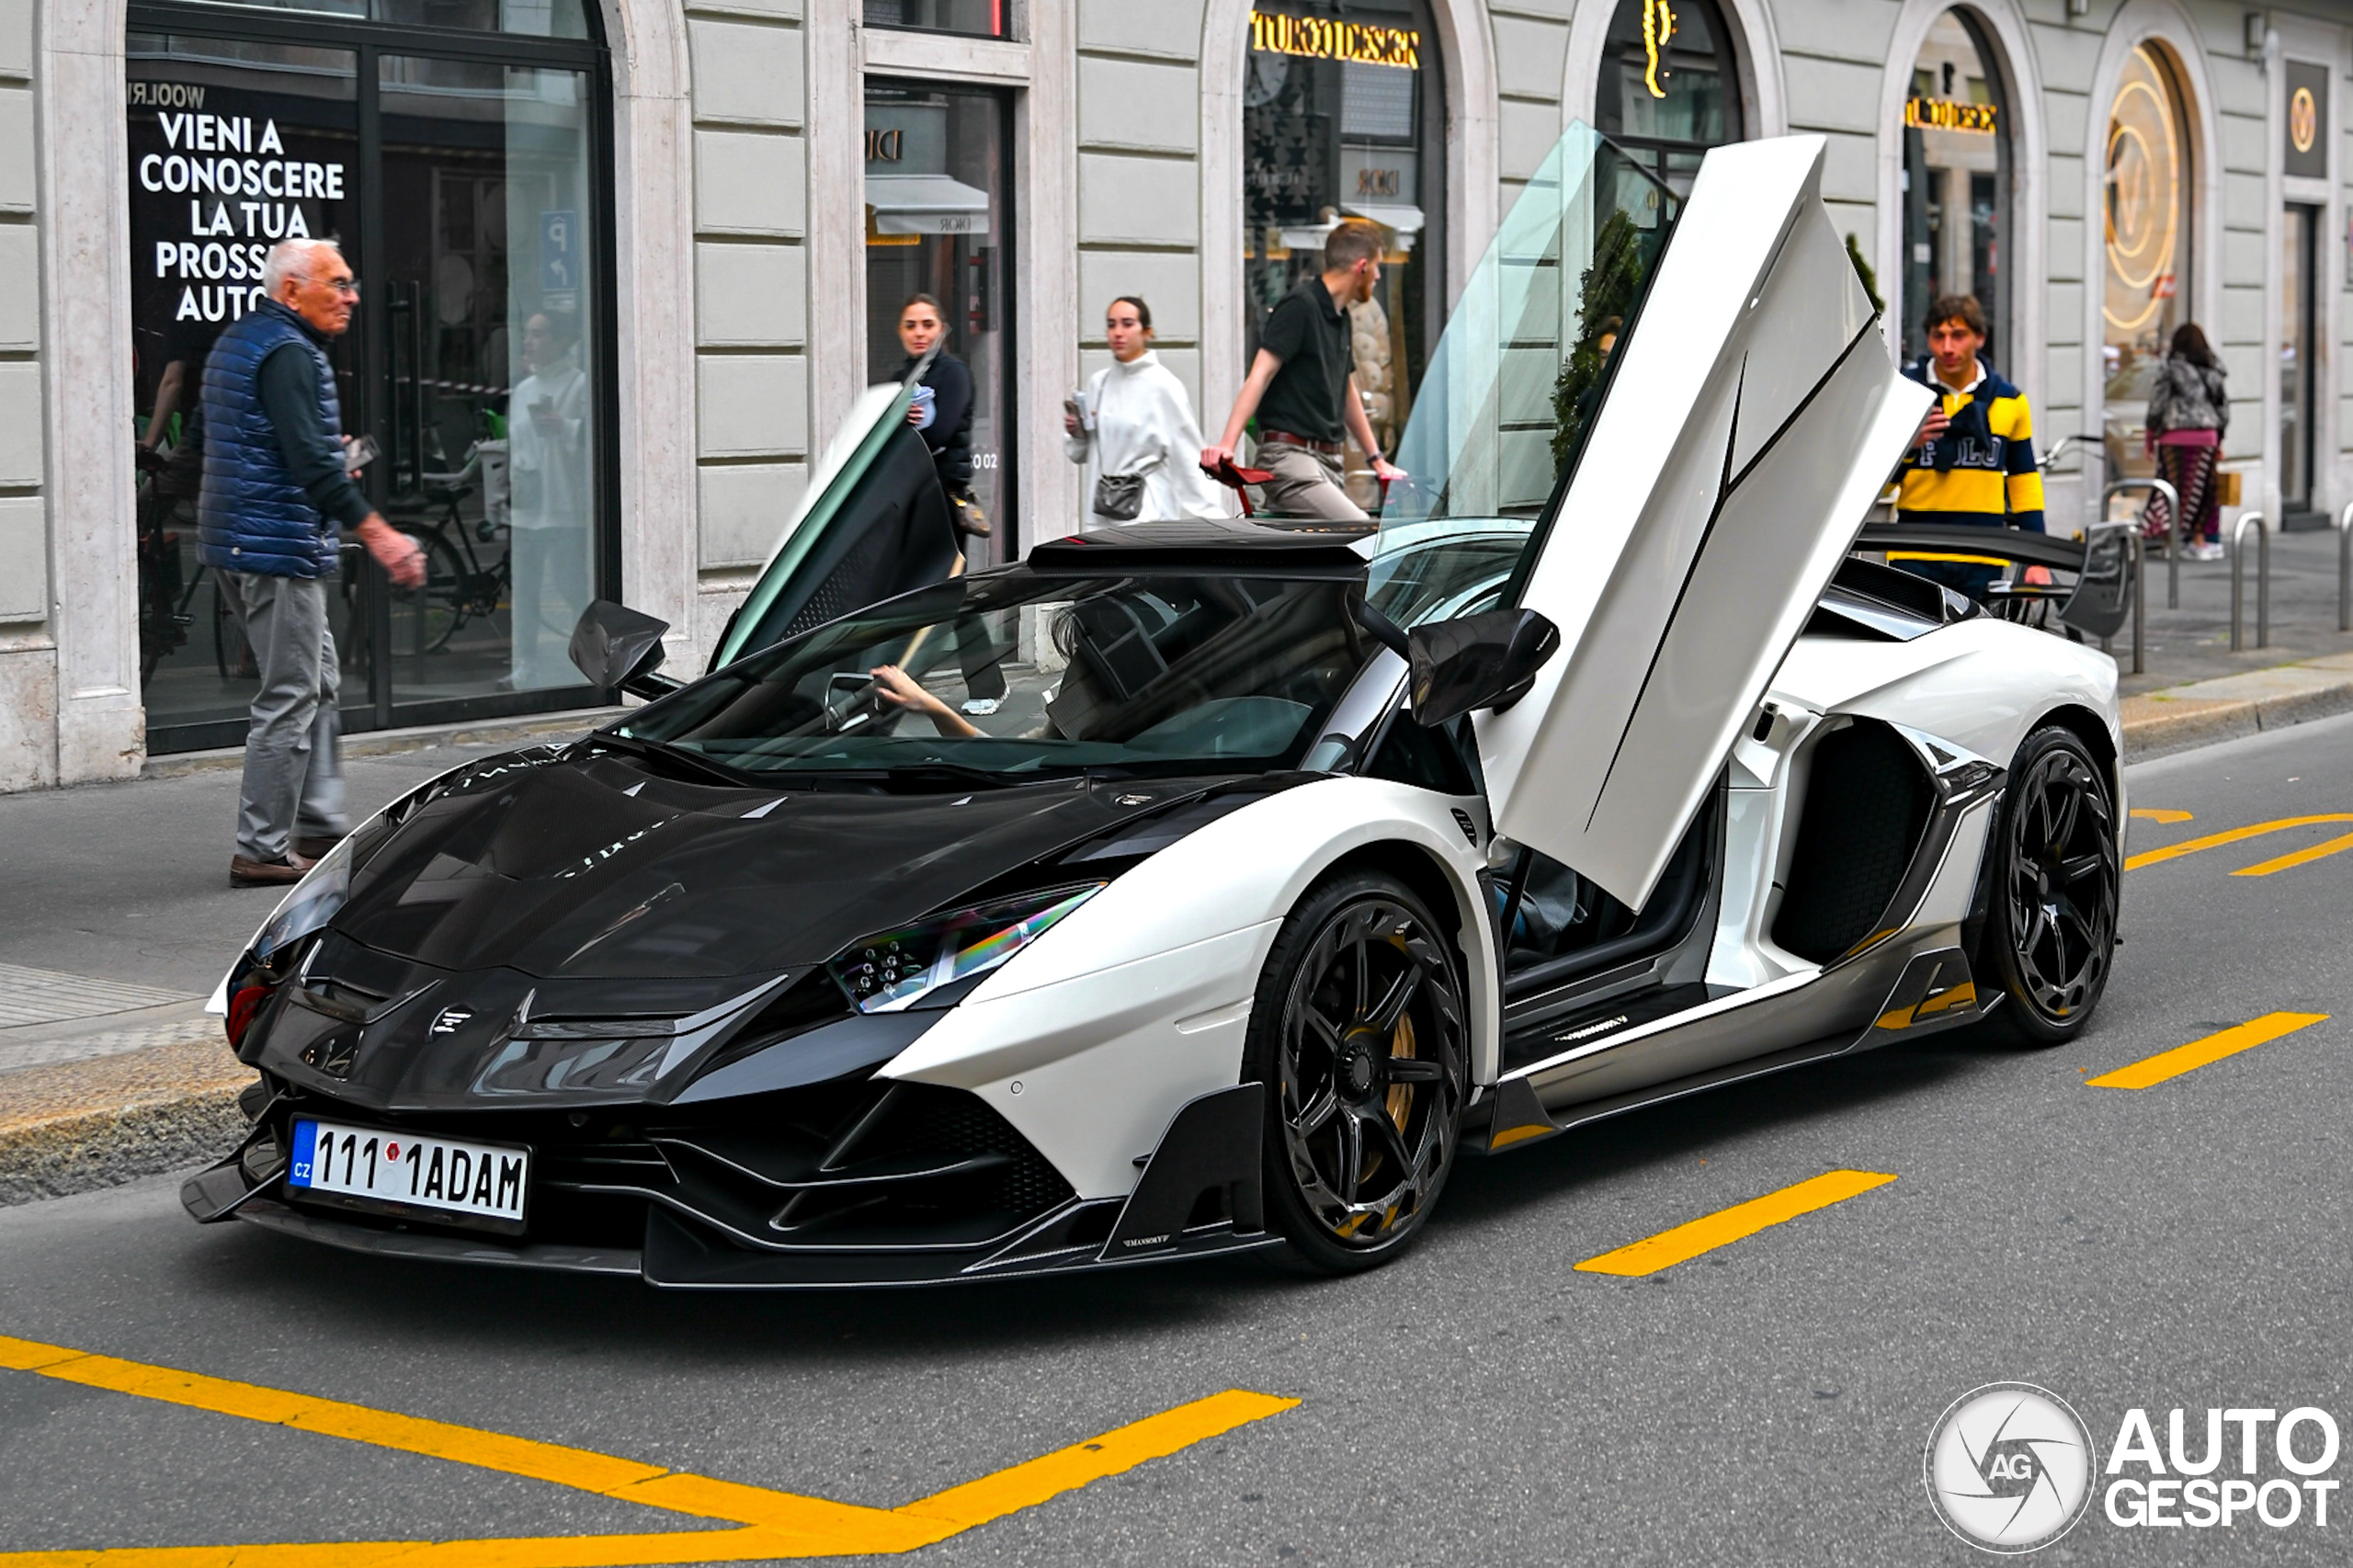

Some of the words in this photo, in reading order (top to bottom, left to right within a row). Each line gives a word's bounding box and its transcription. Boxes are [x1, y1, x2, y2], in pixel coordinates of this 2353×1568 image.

[158, 111, 252, 153] VIENI
[258, 118, 284, 154] A
[140, 153, 345, 199] CONOSCERE
[191, 199, 234, 236] LA
[240, 202, 310, 239] TUA
[156, 241, 276, 280] PROSS
[1919, 436, 2002, 468] PLO
[294, 1163, 311, 1178] CZ
[319, 1131, 379, 1189] 111
[406, 1143, 523, 1211] 1ADAM
